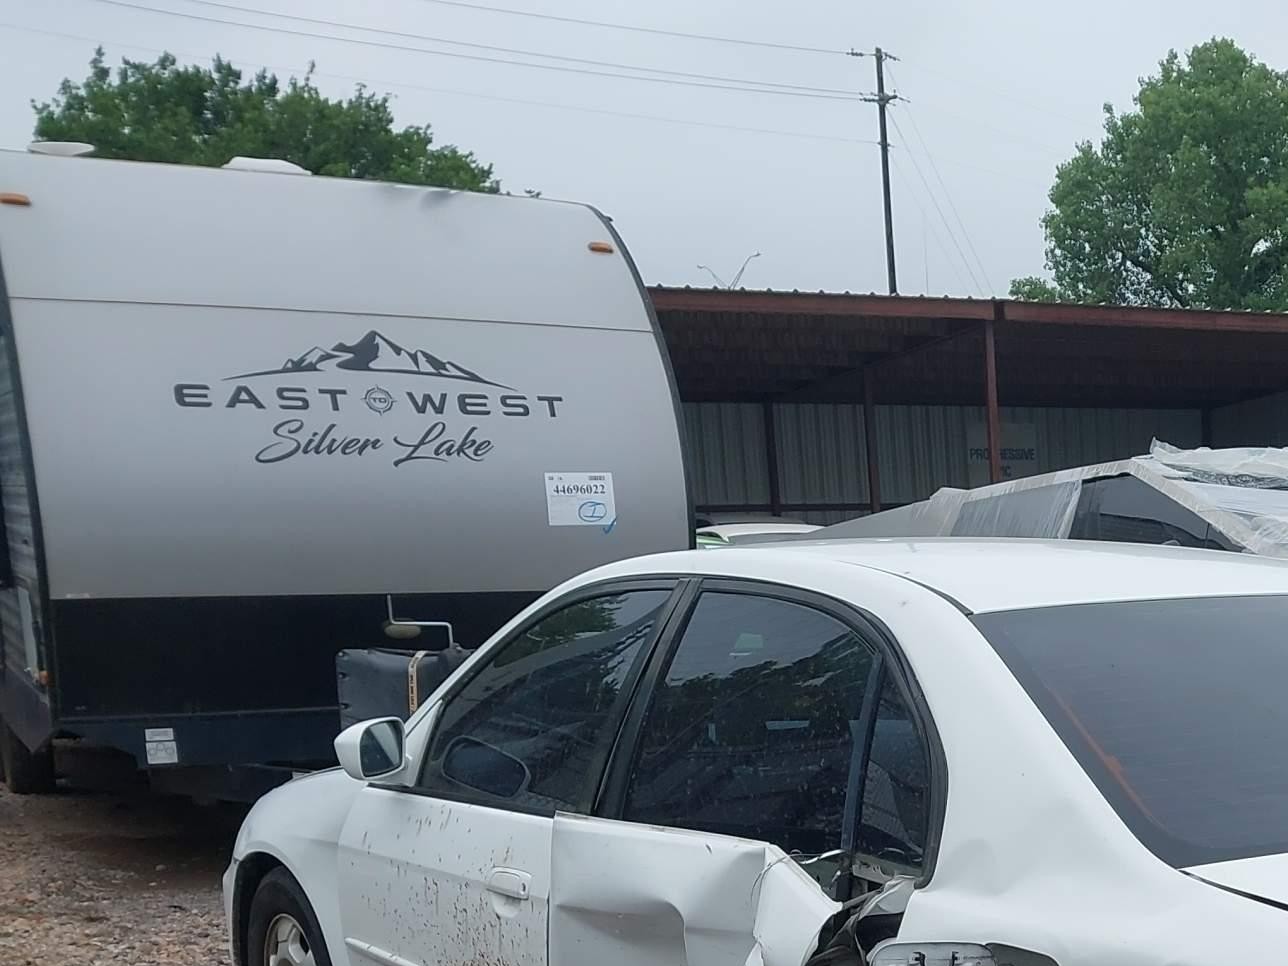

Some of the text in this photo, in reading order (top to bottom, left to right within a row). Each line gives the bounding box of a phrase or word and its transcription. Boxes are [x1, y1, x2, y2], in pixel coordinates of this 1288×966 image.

[174, 383, 347, 411] EAST
[406, 391, 563, 418] WEST
[255, 419, 494, 468] Silver Lake
[553, 484, 606, 495] 44696022
